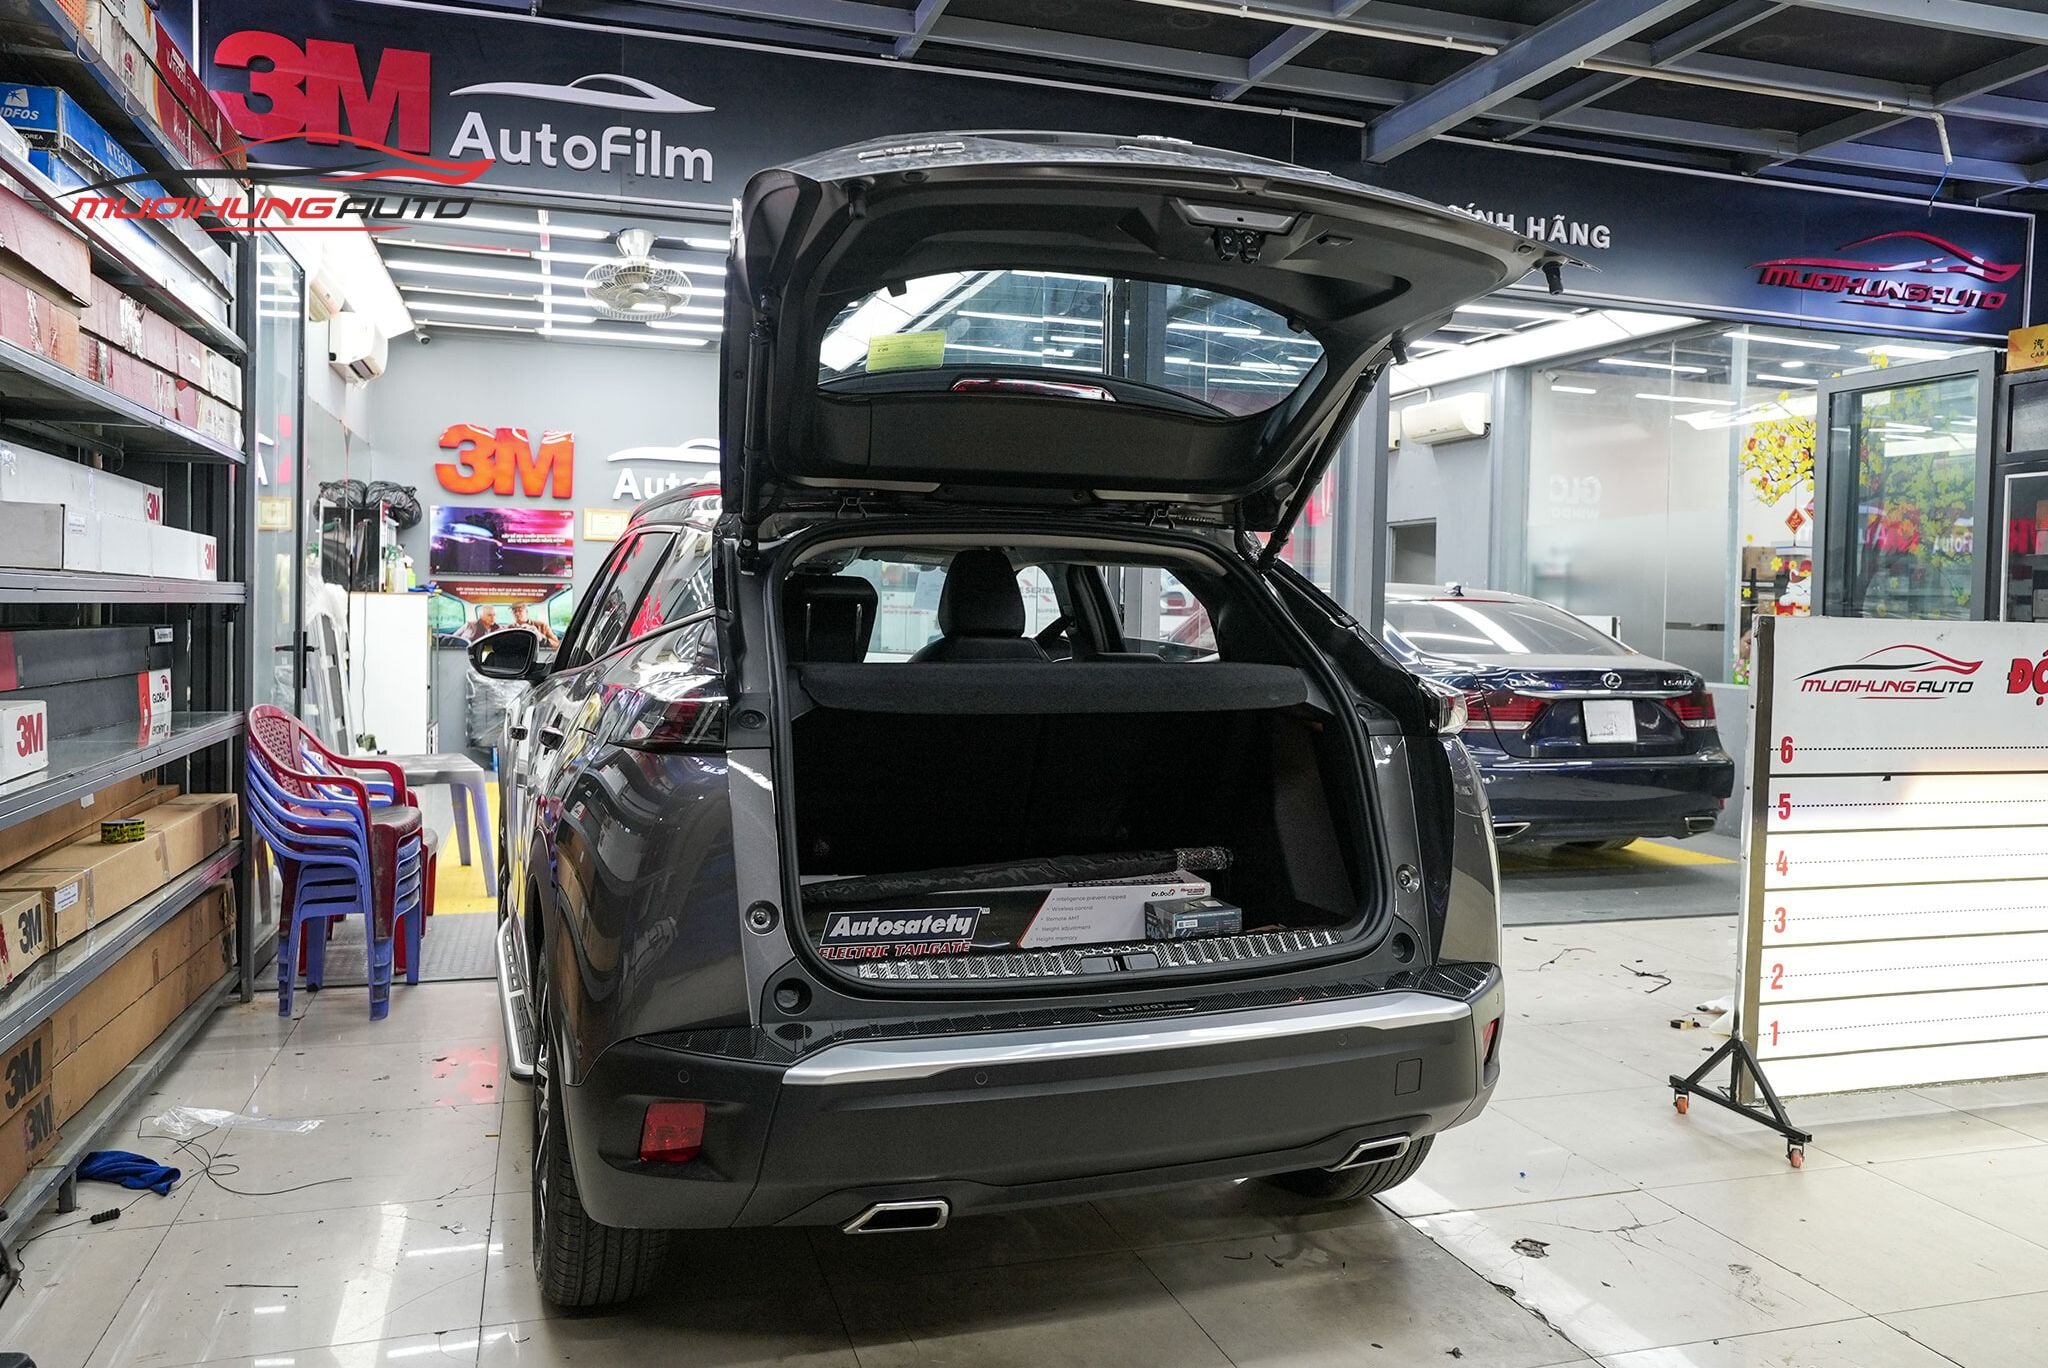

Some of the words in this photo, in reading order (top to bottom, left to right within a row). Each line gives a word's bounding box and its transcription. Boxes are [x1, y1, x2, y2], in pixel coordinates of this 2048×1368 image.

[214, 30, 431, 154] 3M
[449, 111, 713, 182] AutoFilm
[1526, 215, 1611, 248] HÃNG
[435, 424, 575, 498] 3M
[612, 467, 720, 500] Aut
[147, 493, 160, 521] 3M
[204, 543, 215, 570] 3M
[16, 711, 43, 758] 3M
[1781, 736, 1793, 764] 6
[1778, 793, 1791, 820] 5
[1776, 851, 1788, 877] 4
[18, 903, 42, 954] 3M
[829, 914, 973, 937] Autosafety
[1774, 907, 1786, 933] 3
[819, 945, 889, 960] ELECTRIC
[895, 941, 972, 957] TAILGATE
[1771, 963, 1783, 990] 2
[1770, 1020, 1779, 1046] 1
[5, 1037, 42, 1110] 3M
[25, 1094, 53, 1152] 3M
